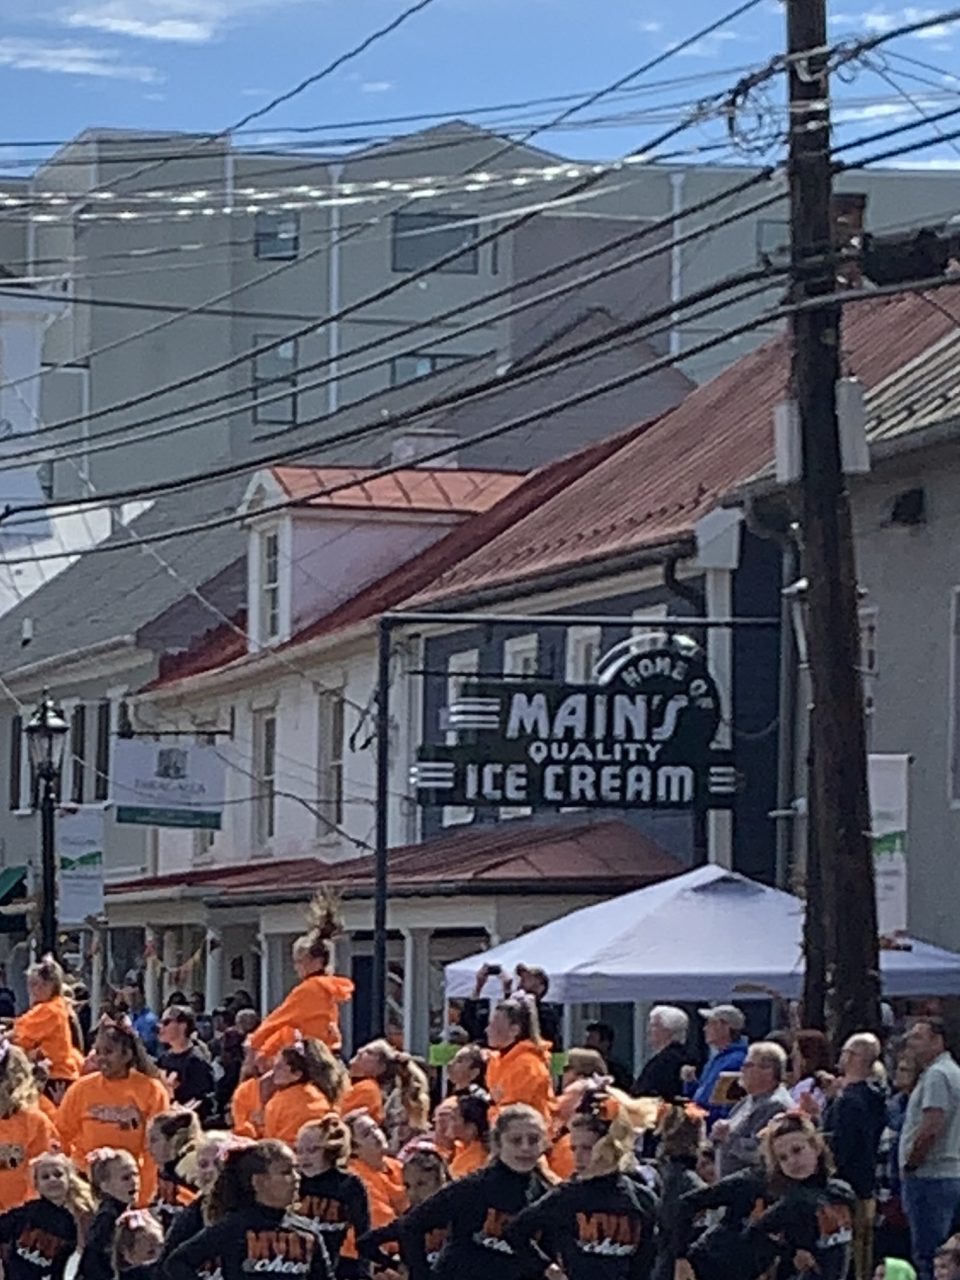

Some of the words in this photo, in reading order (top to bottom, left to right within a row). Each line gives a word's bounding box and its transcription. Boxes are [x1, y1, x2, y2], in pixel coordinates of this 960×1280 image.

[621, 657, 689, 688] HOME
[506, 692, 689, 741] MAIN'S
[529, 741, 663, 764] QUALITY
[465, 763, 528, 801] ICE
[543, 765, 695, 802] CREAM
